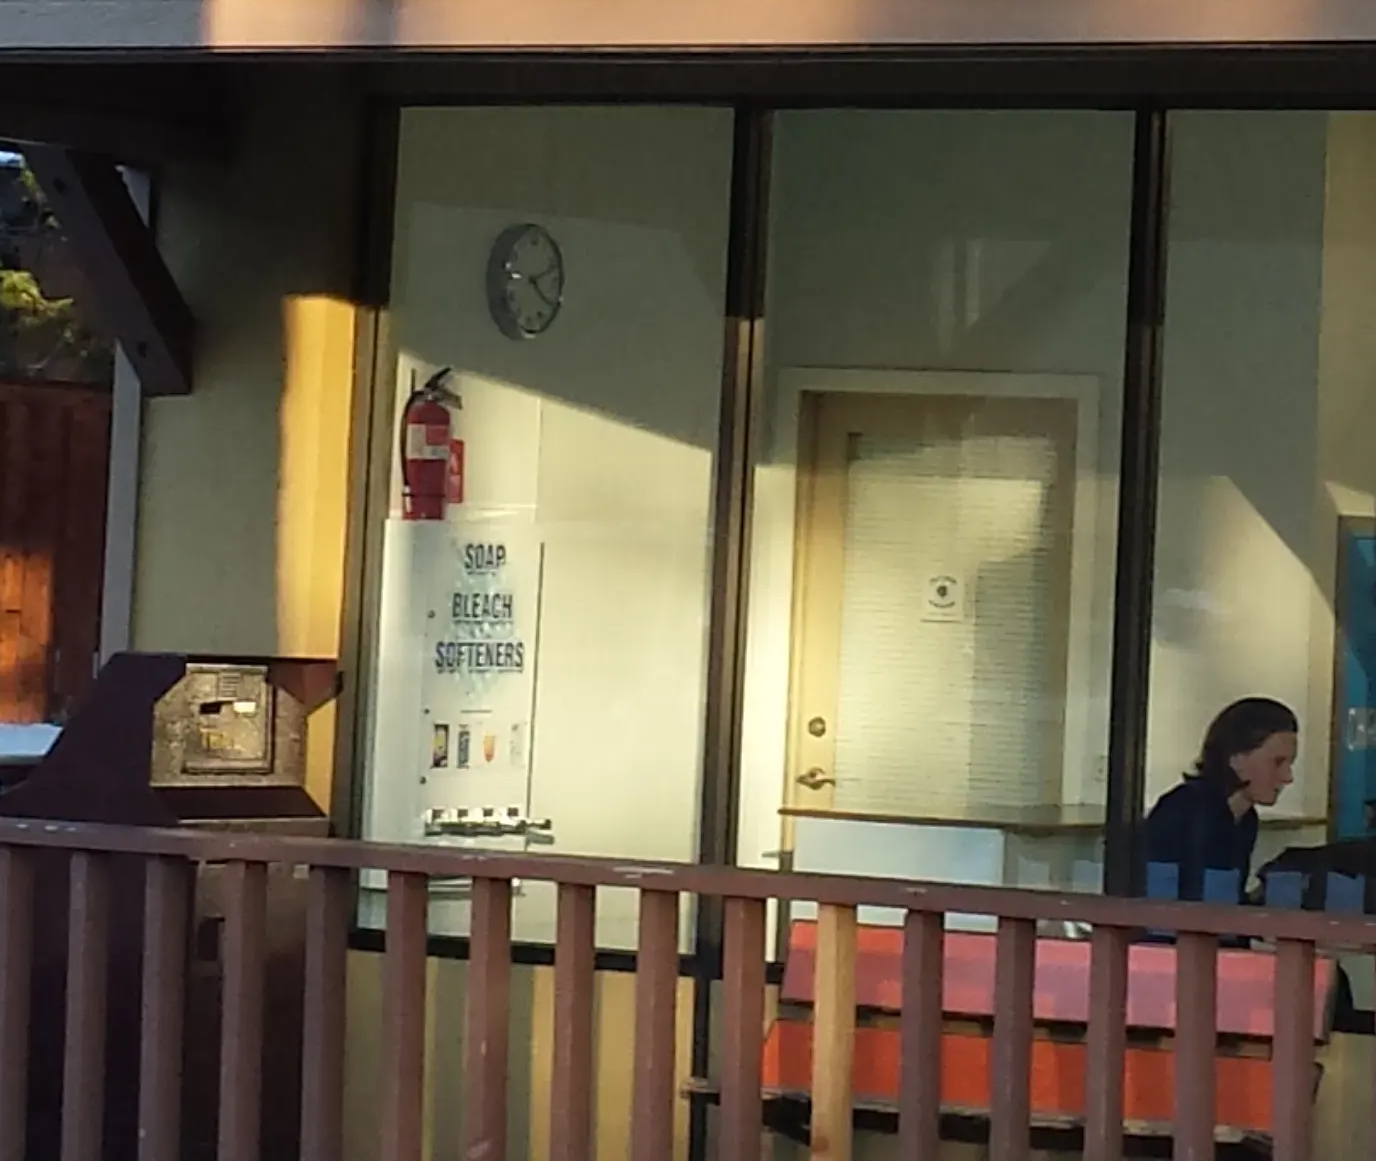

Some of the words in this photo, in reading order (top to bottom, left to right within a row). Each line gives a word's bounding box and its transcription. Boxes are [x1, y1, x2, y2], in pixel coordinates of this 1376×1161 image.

[464, 543, 506, 570] SOAP
[452, 592, 513, 619] BLEACH
[434, 641, 524, 669] SOFTENERS
